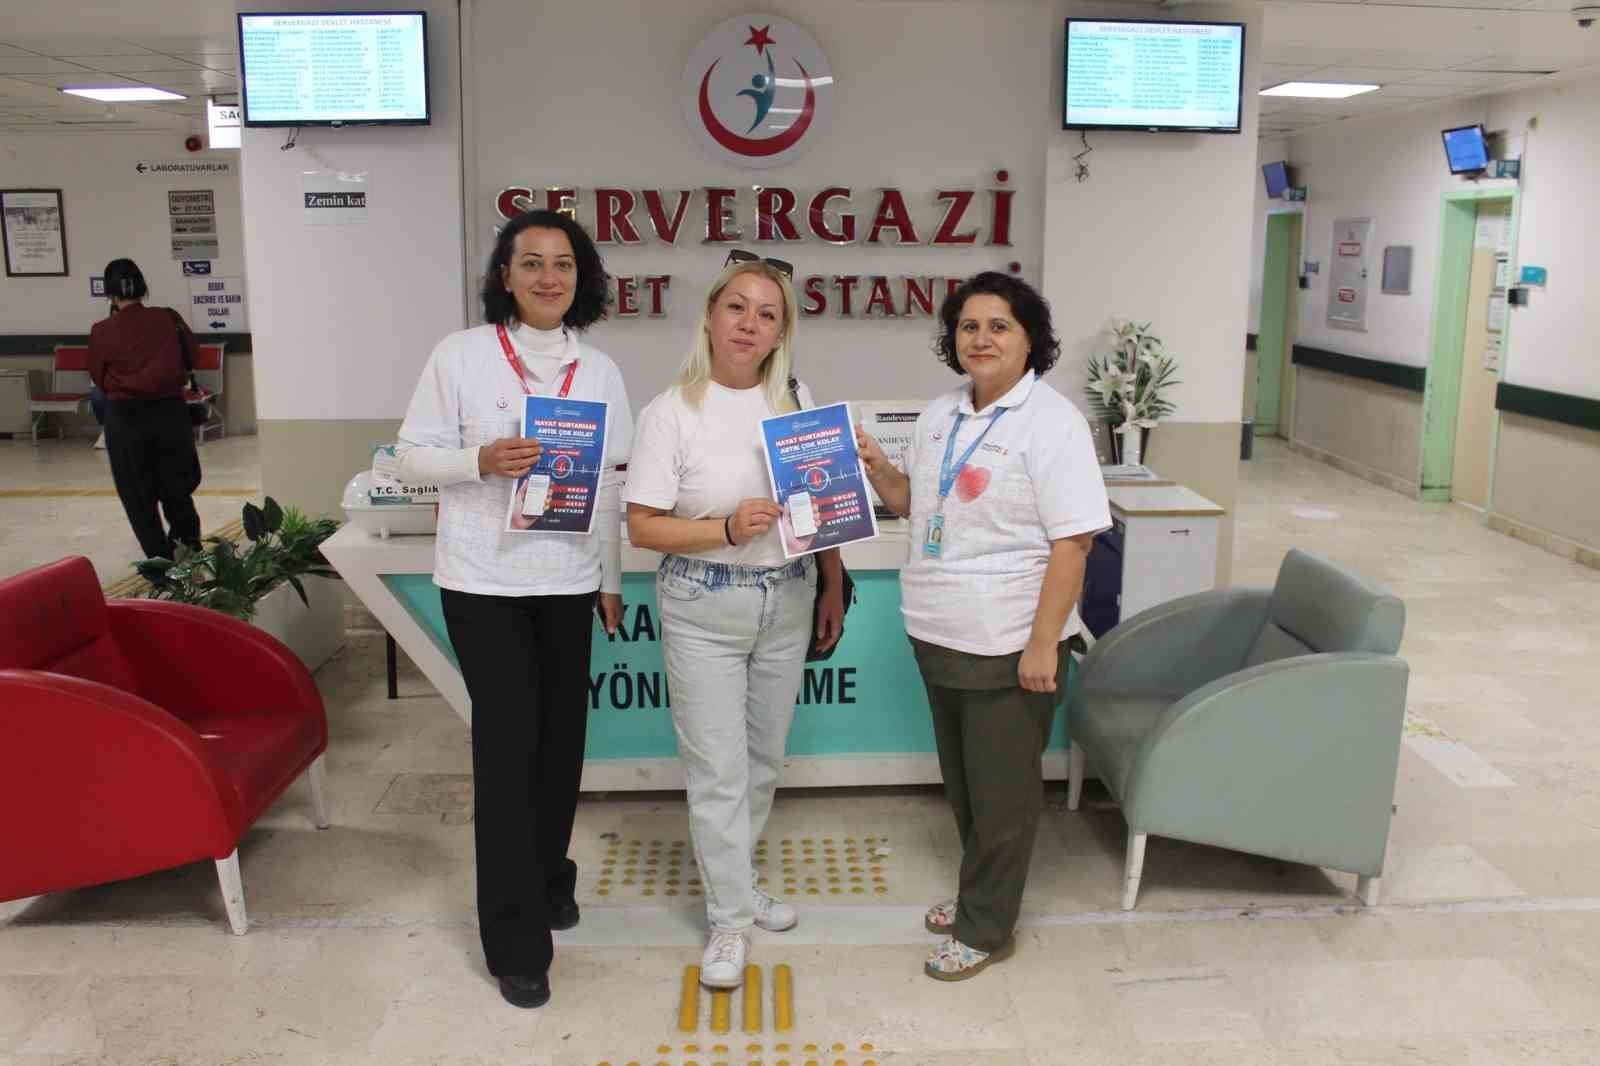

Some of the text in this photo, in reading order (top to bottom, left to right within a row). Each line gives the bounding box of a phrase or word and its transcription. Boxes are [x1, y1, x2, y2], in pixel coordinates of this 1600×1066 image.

[150, 163, 230, 173] LABORATUVARLAR
[308, 195, 366, 206] Zemin kat
[534, 419, 557, 427] HAYAT
[775, 437, 798, 447] HAYAT
